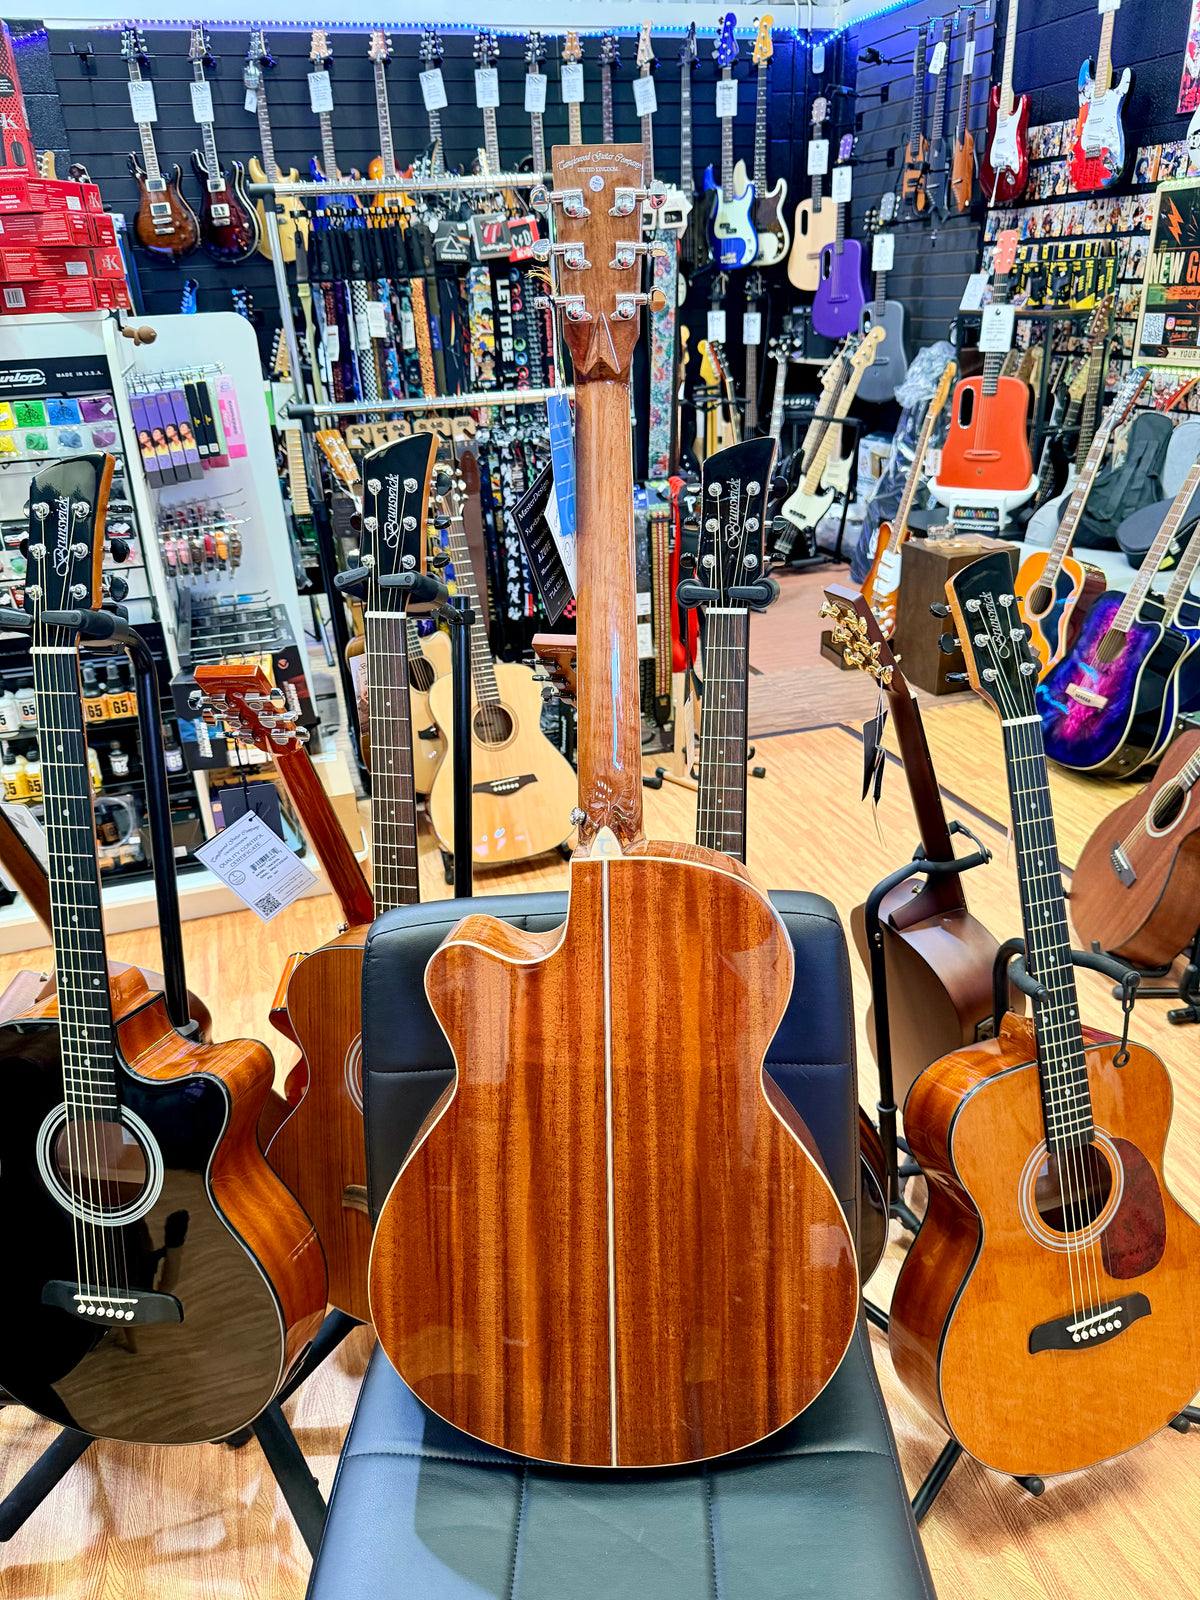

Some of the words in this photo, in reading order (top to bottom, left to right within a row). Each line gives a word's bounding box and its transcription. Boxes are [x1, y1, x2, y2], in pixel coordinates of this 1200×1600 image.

[557, 152, 591, 170] Tanglewood
[592, 150, 614, 163] Guitar
[614, 153, 642, 170] Company
[1149, 251, 1186, 284] NEW
[495, 279, 511, 314] LET
[500, 315, 513, 336] IT
[501, 337, 514, 362] BE
[1180, 351, 1197, 359] YOUR
[383, 473, 399, 548] Brunswick
[518, 479, 549, 521] MasterDesign
[724, 478, 741, 549] Brunswick
[53, 495, 69, 576] Brunswick
[979, 591, 1010, 659] Brunswick
[22, 704, 35, 716] 65
[88, 705, 103, 718] 65
[113, 700, 128, 714] 65
[170, 757, 182, 768] 65
[28, 780, 41, 792] 65
[219, 850, 240, 869] QUALITY
[239, 833, 264, 853] CONTROL
[230, 841, 261, 868] CERTIFICATE
